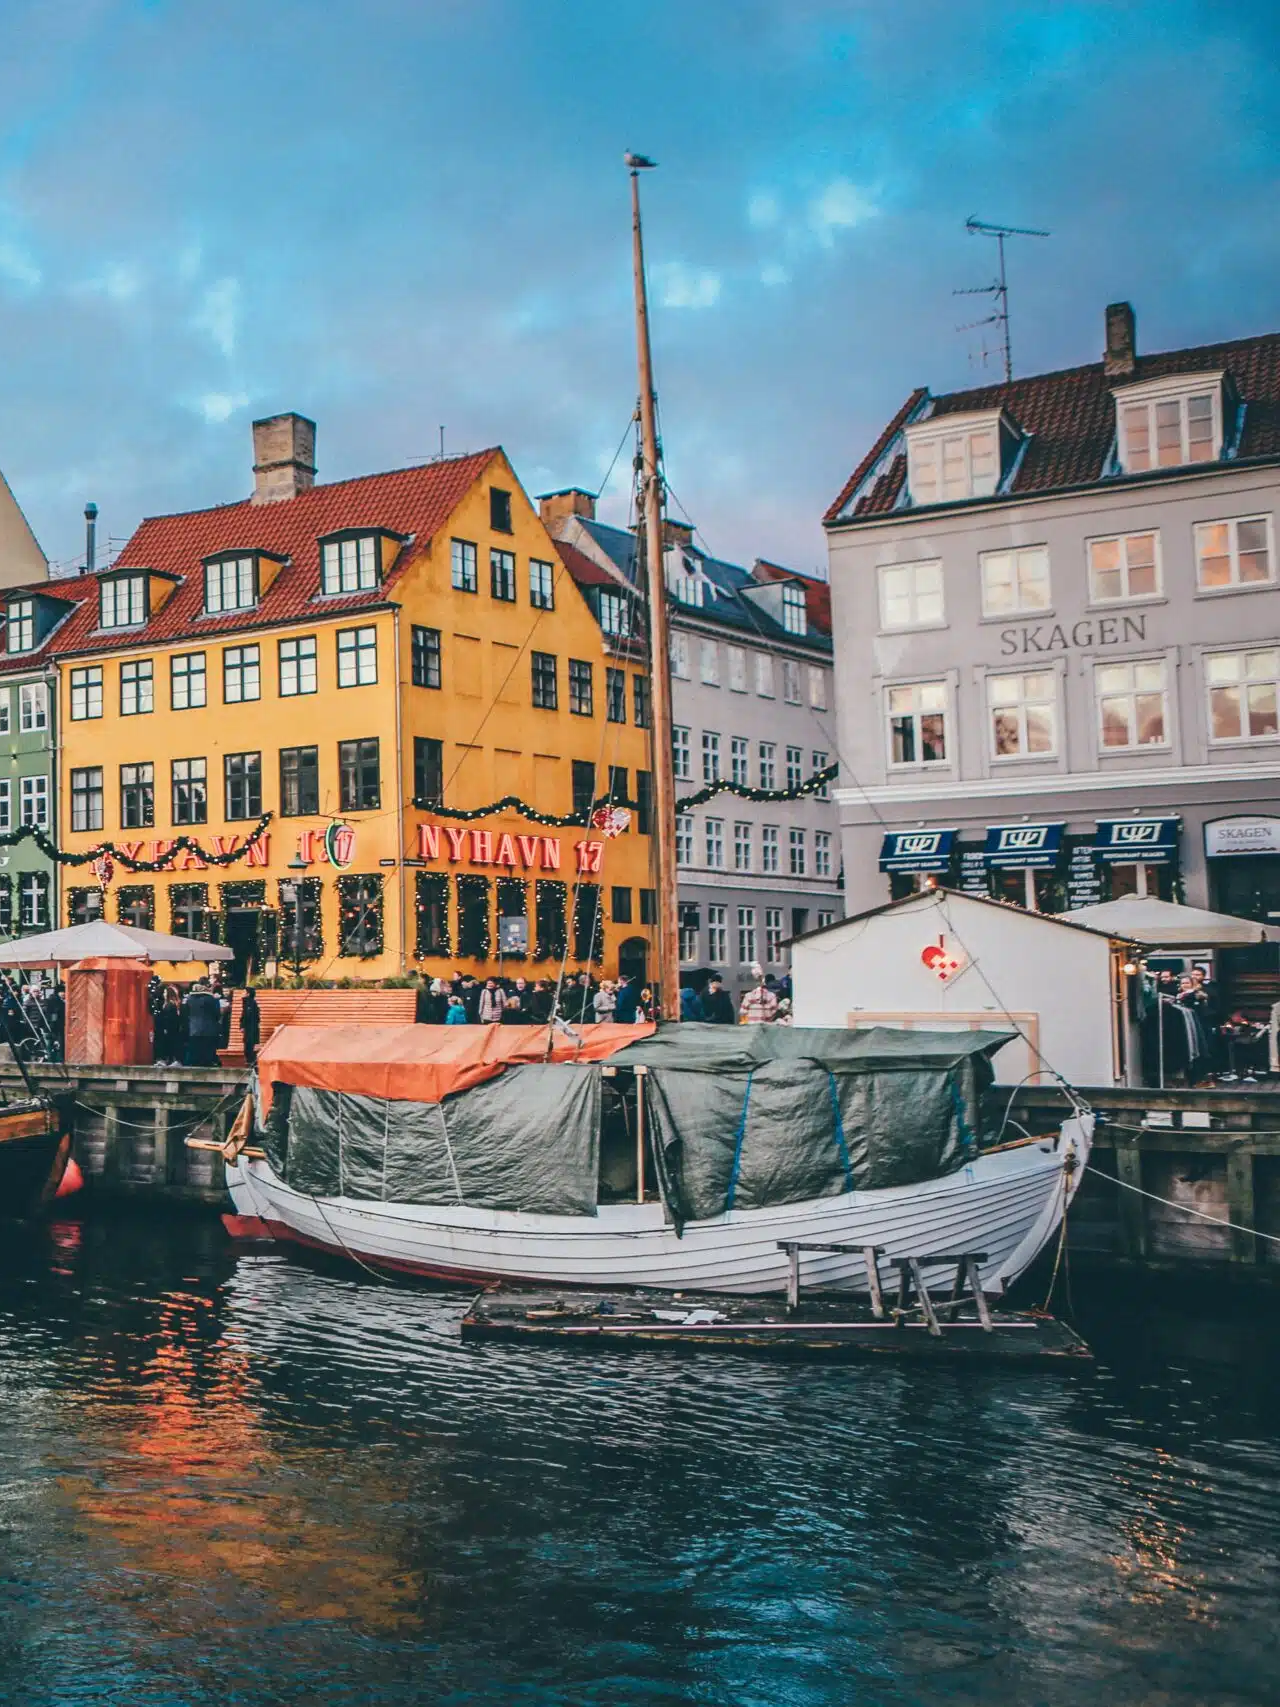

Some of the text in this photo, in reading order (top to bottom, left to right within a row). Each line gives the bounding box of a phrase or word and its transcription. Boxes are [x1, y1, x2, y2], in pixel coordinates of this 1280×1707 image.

[1000, 614, 1147, 656] SKAGEN
[420, 824, 604, 873] NYHAVN 17
[1217, 827, 1273, 840] SKAGEN
